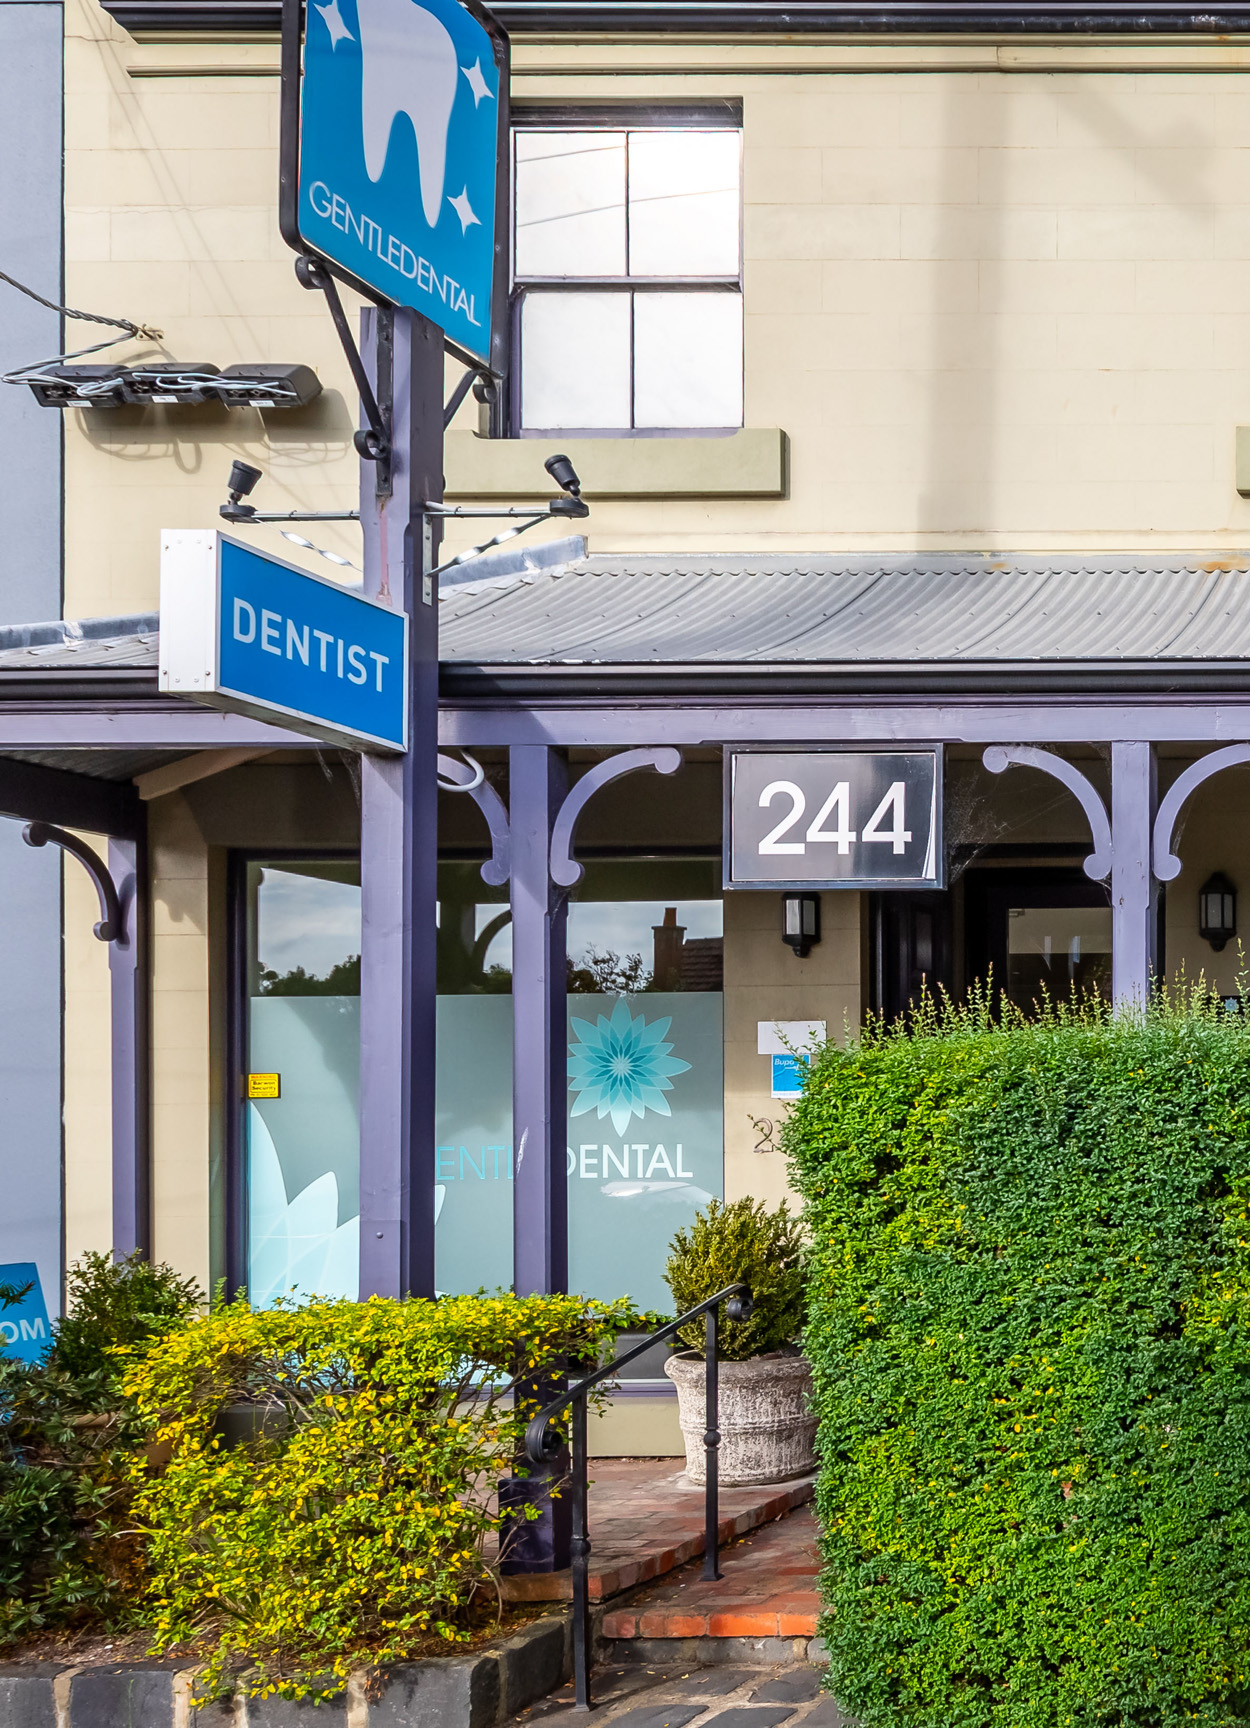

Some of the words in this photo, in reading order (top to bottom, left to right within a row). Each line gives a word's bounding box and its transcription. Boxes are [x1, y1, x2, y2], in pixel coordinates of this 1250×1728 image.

[309, 181, 482, 328] GENTLEDENTAL
[233, 596, 390, 693] DENTIST
[758, 780, 913, 855] 244
[774, 1058, 795, 1067] Bupa
